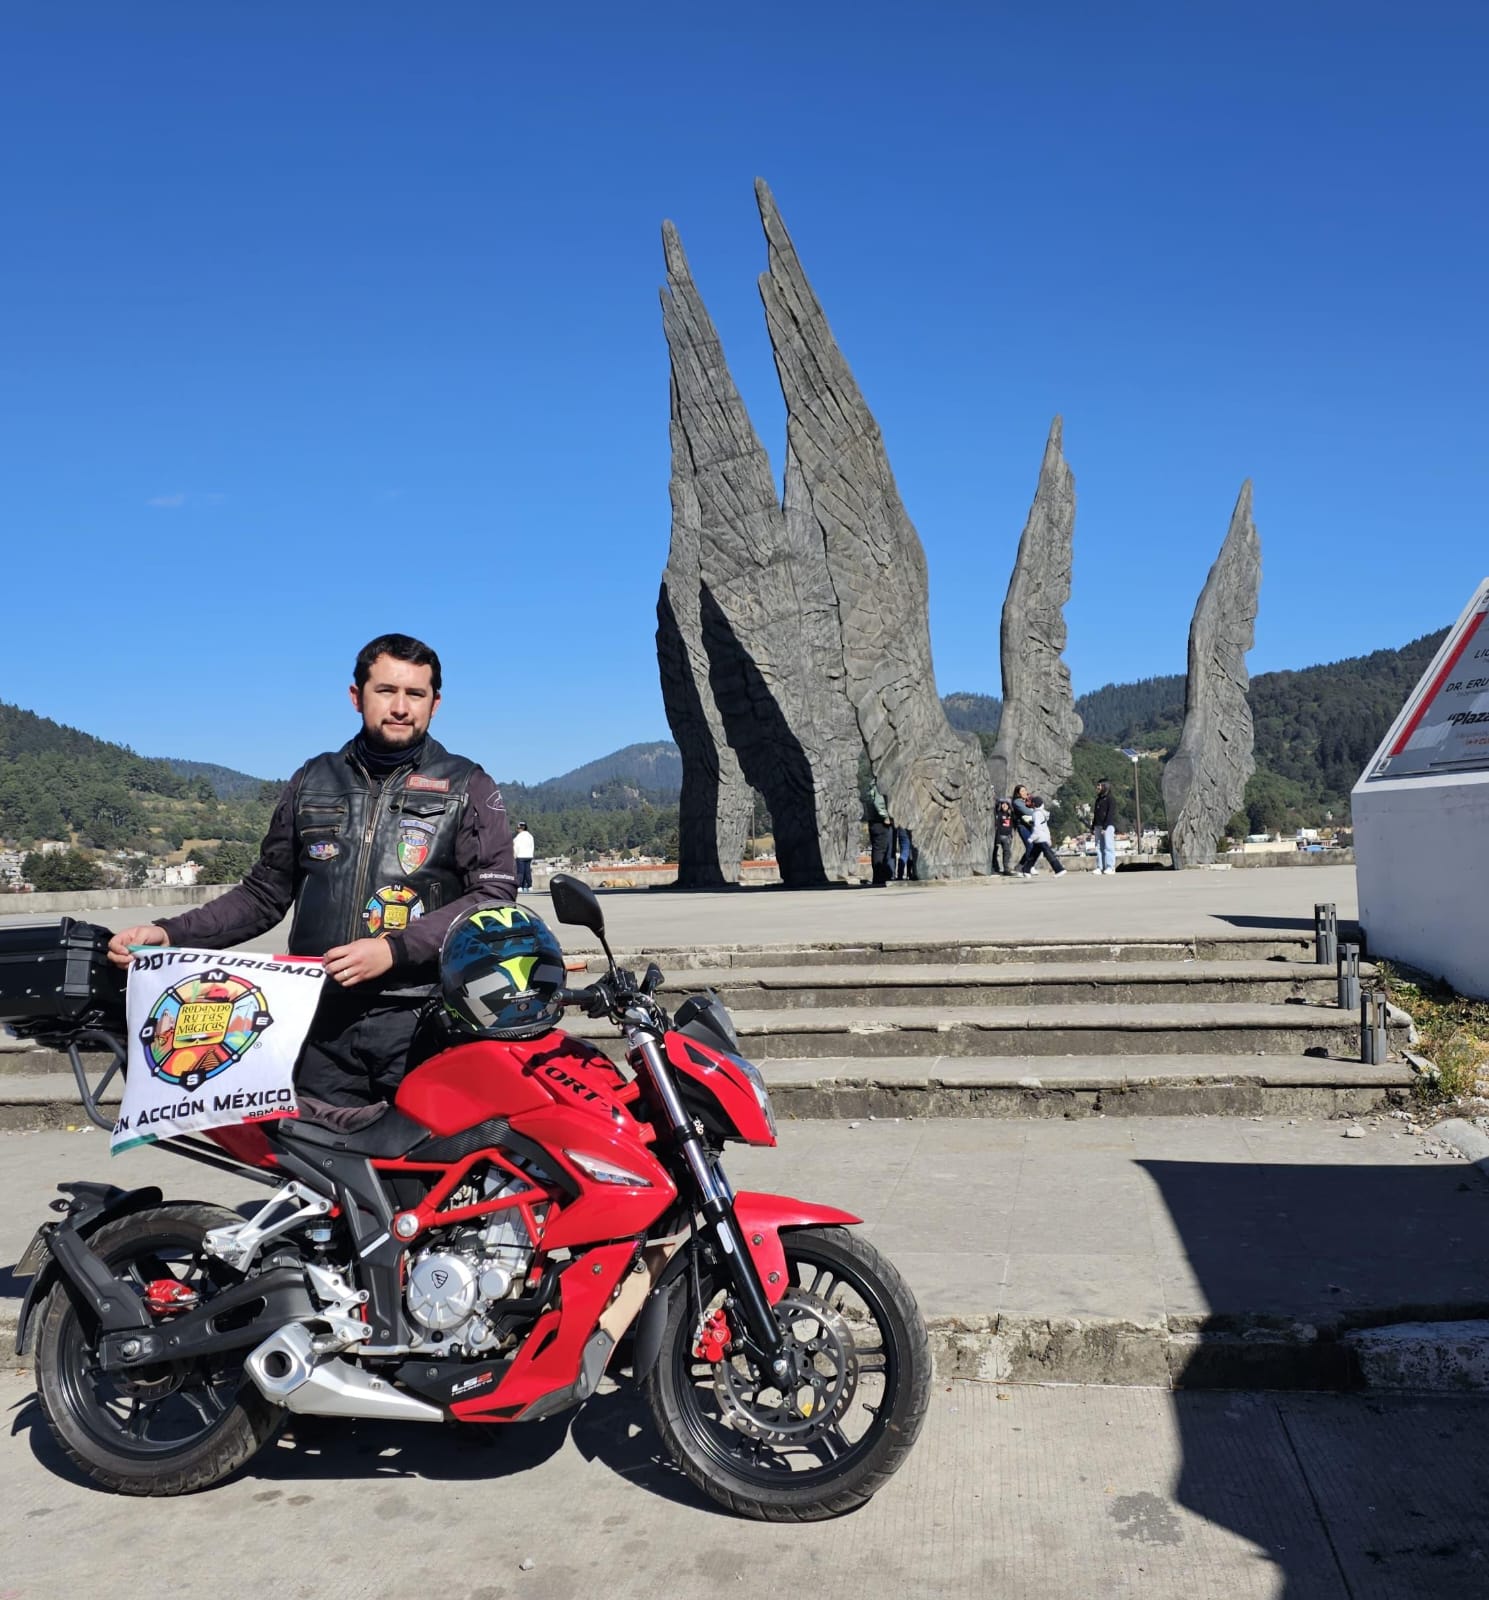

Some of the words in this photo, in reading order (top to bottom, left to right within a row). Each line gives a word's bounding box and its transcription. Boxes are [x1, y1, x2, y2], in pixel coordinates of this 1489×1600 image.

[1445, 682, 1463, 692] DR.
[207, 971, 222, 980] N
[255, 1017, 268, 1026] E
[186, 1074, 198, 1085] S
[136, 1096, 204, 1127] ACCIÓN
[213, 1088, 292, 1112] MÉXICO
[451, 1371, 492, 1393] LS2
